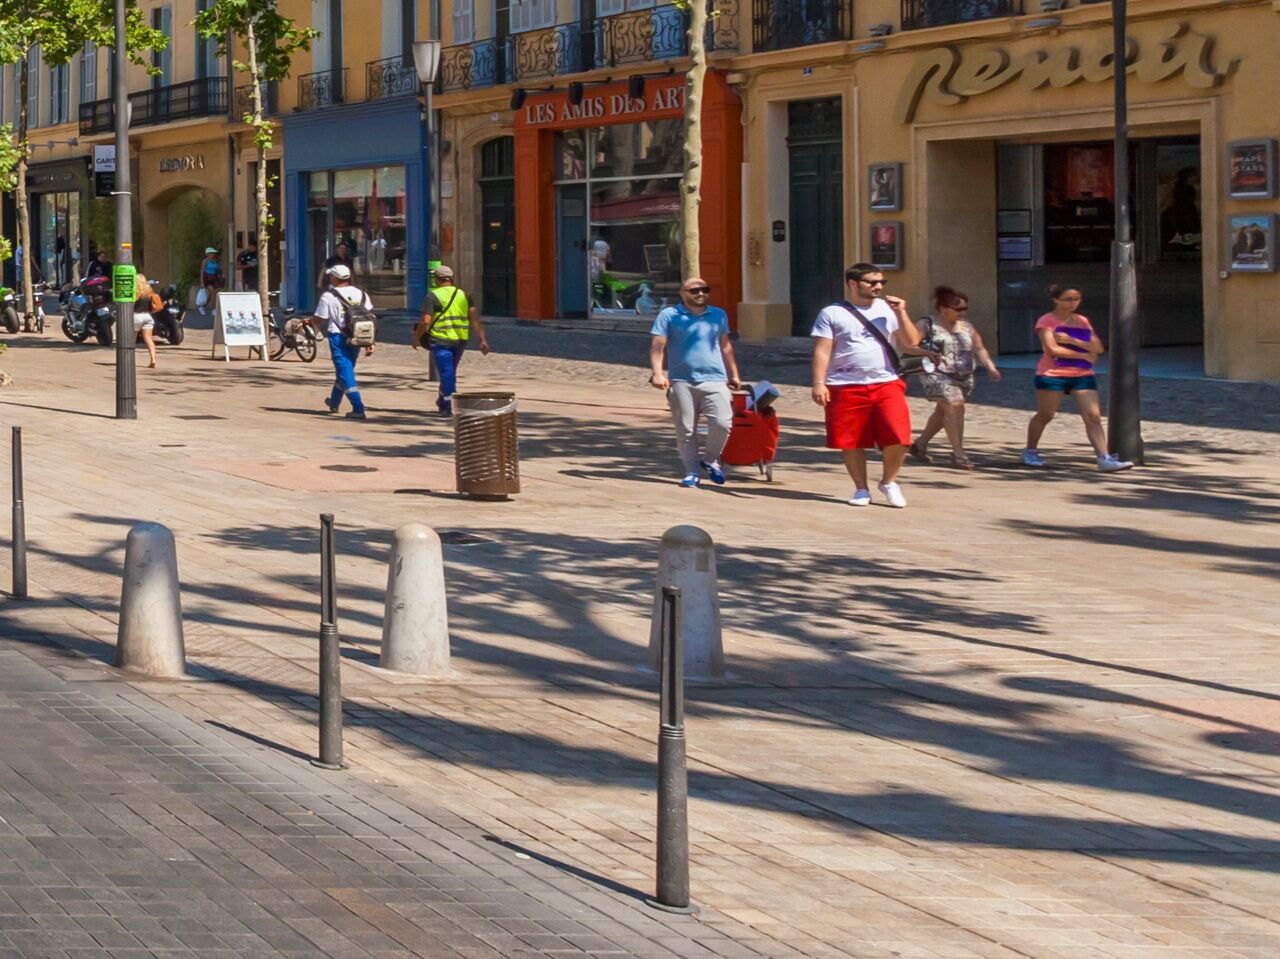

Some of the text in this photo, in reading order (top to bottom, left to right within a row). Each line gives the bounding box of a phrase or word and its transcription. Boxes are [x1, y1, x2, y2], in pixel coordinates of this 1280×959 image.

[525, 86, 687, 125] LES AMIS DES ART
[894, 22, 1241, 124] Renoir
